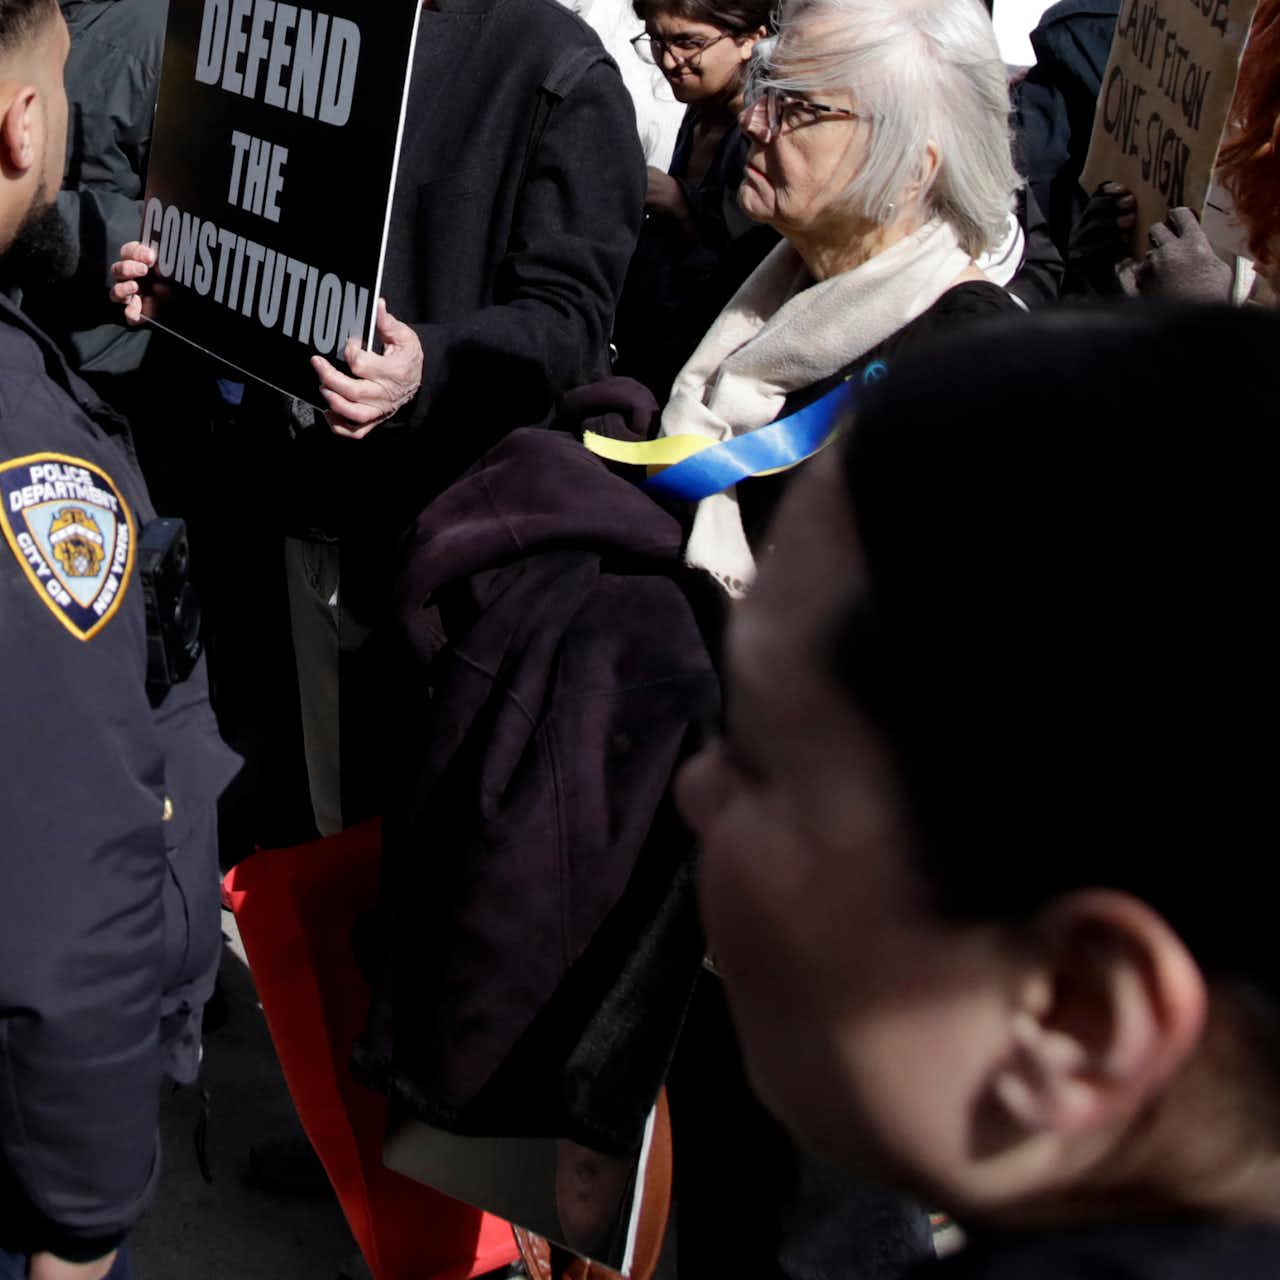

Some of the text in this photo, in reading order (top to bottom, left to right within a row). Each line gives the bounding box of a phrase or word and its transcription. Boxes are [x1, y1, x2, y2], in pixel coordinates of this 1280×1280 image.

[1158, 31, 1191, 105] FIT
[1181, 63, 1211, 131] ON
[227, 130, 290, 223] THE
[1103, 65, 1191, 208] ONE SIGN
[141, 196, 370, 362] CONSTITUTION
[8, 481, 118, 513] DEPARTMENT
[29, 463, 95, 486] POLICE
[16, 531, 73, 607] CITY OF
[92, 522, 130, 616] NEW YORK
